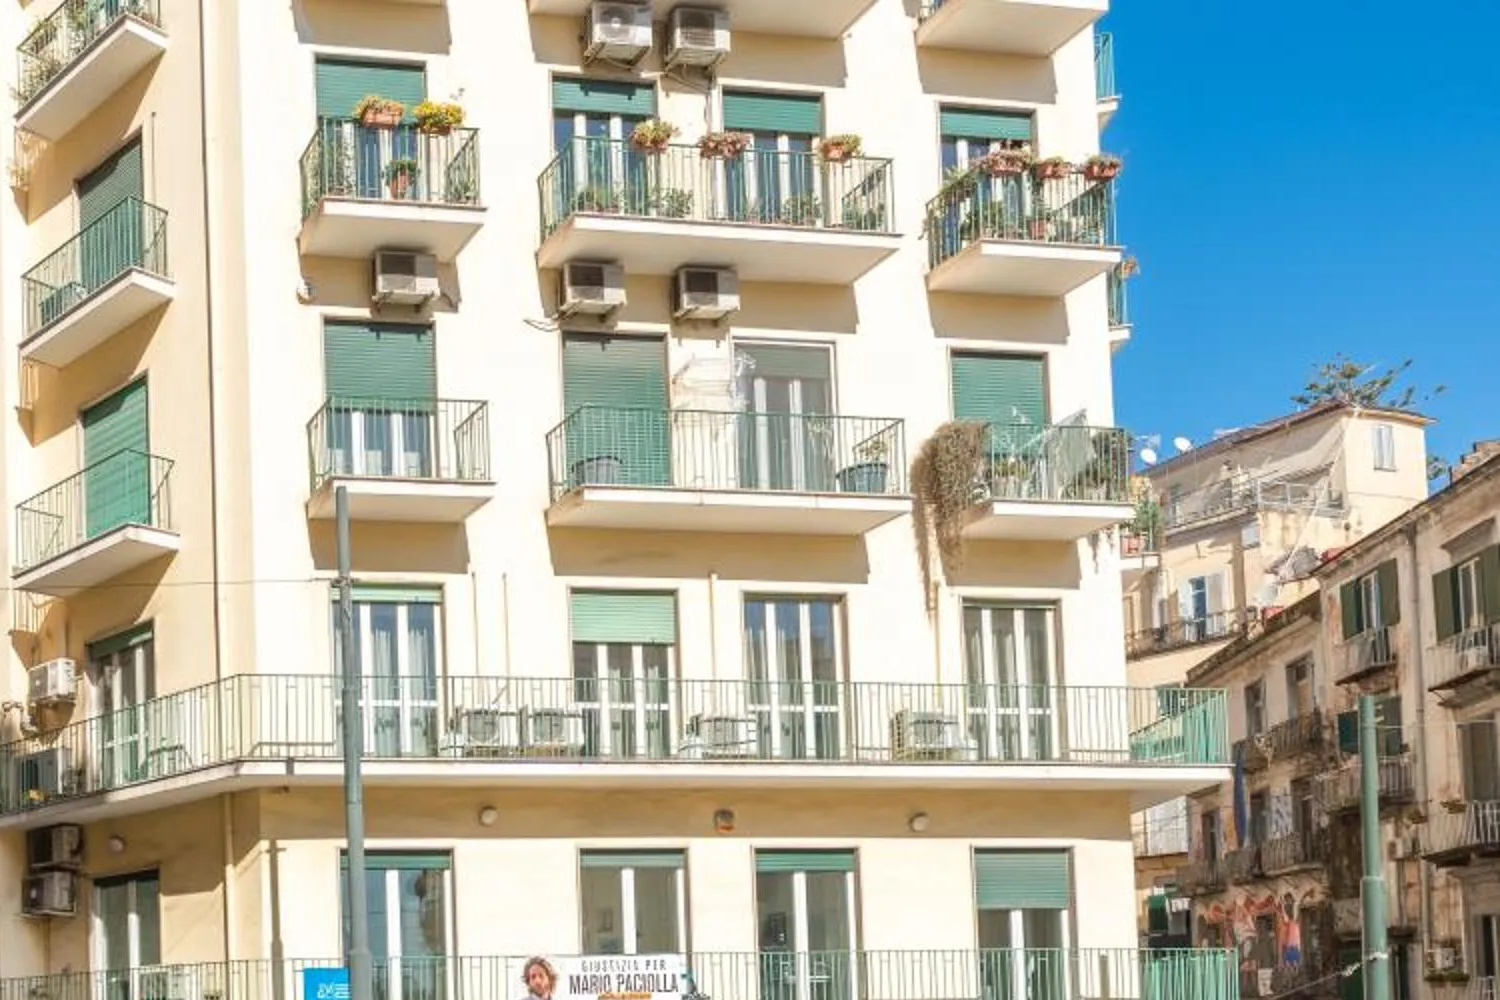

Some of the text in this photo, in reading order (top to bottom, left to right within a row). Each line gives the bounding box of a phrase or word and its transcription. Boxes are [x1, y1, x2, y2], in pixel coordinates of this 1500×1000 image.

[646, 959, 666, 970] PER
[569, 972, 678, 994] MARIO PACIOLLA
